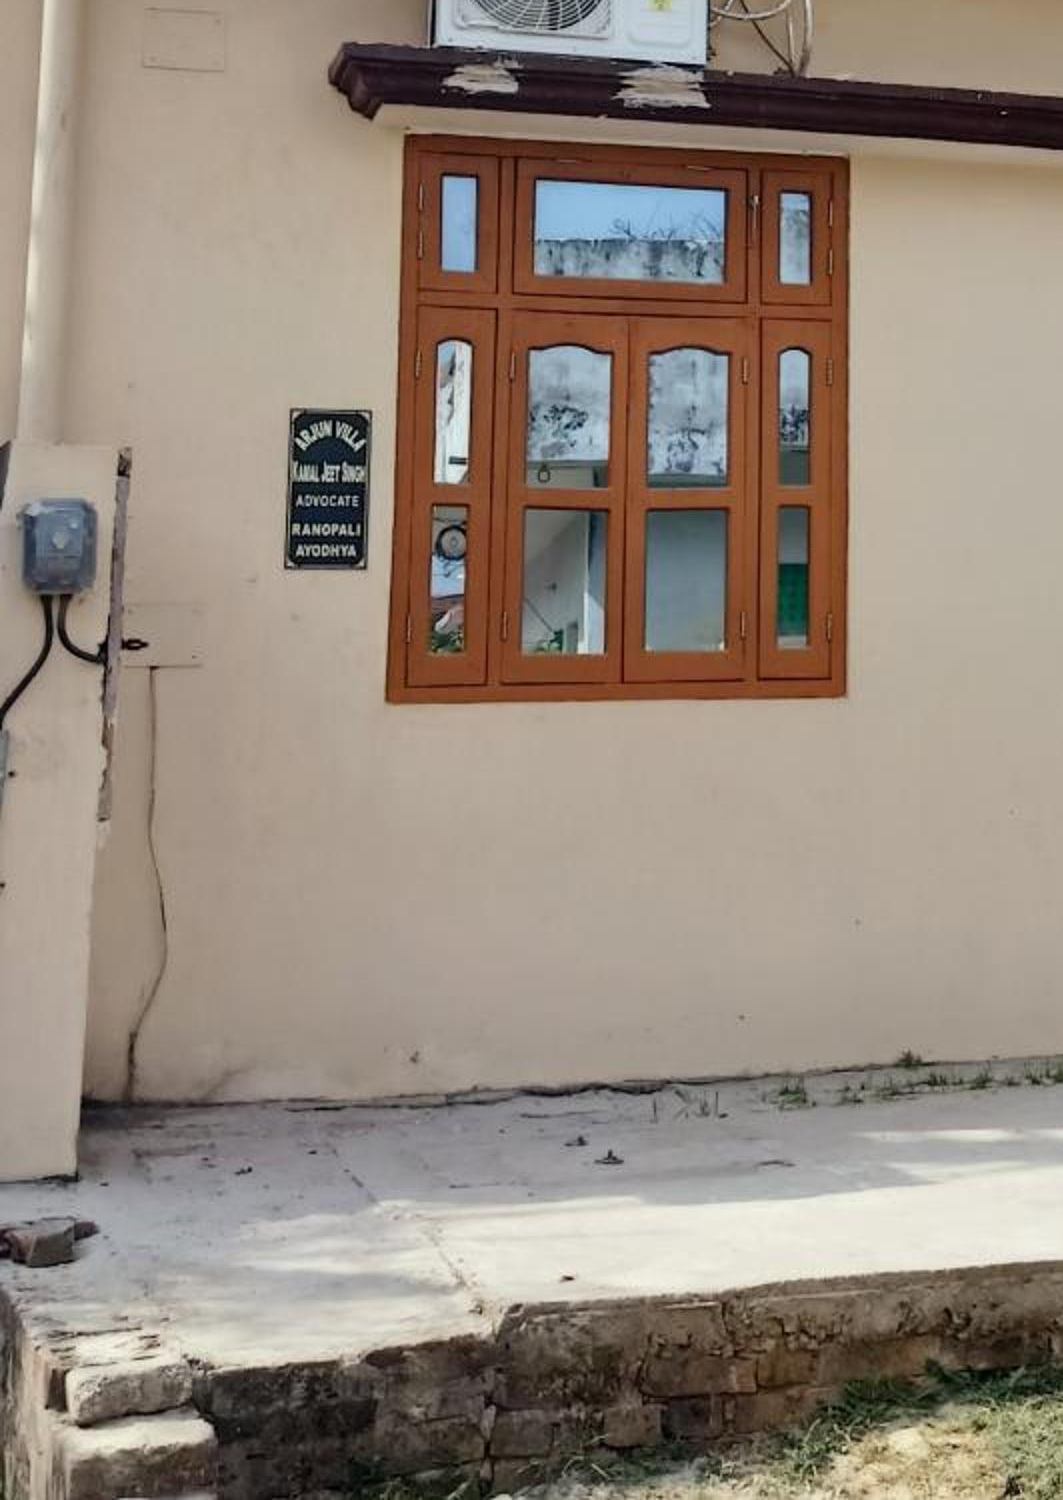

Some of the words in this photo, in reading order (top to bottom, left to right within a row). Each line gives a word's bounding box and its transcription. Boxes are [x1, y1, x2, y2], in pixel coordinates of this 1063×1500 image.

[295, 419, 334, 451] ARJUN
[335, 420, 367, 453] VILLA
[321, 460, 341, 483] JEET
[295, 495, 360, 508] ADVOCATE
[291, 523, 361, 537] RANOPALI
[295, 544, 357, 557] AYODHYA
